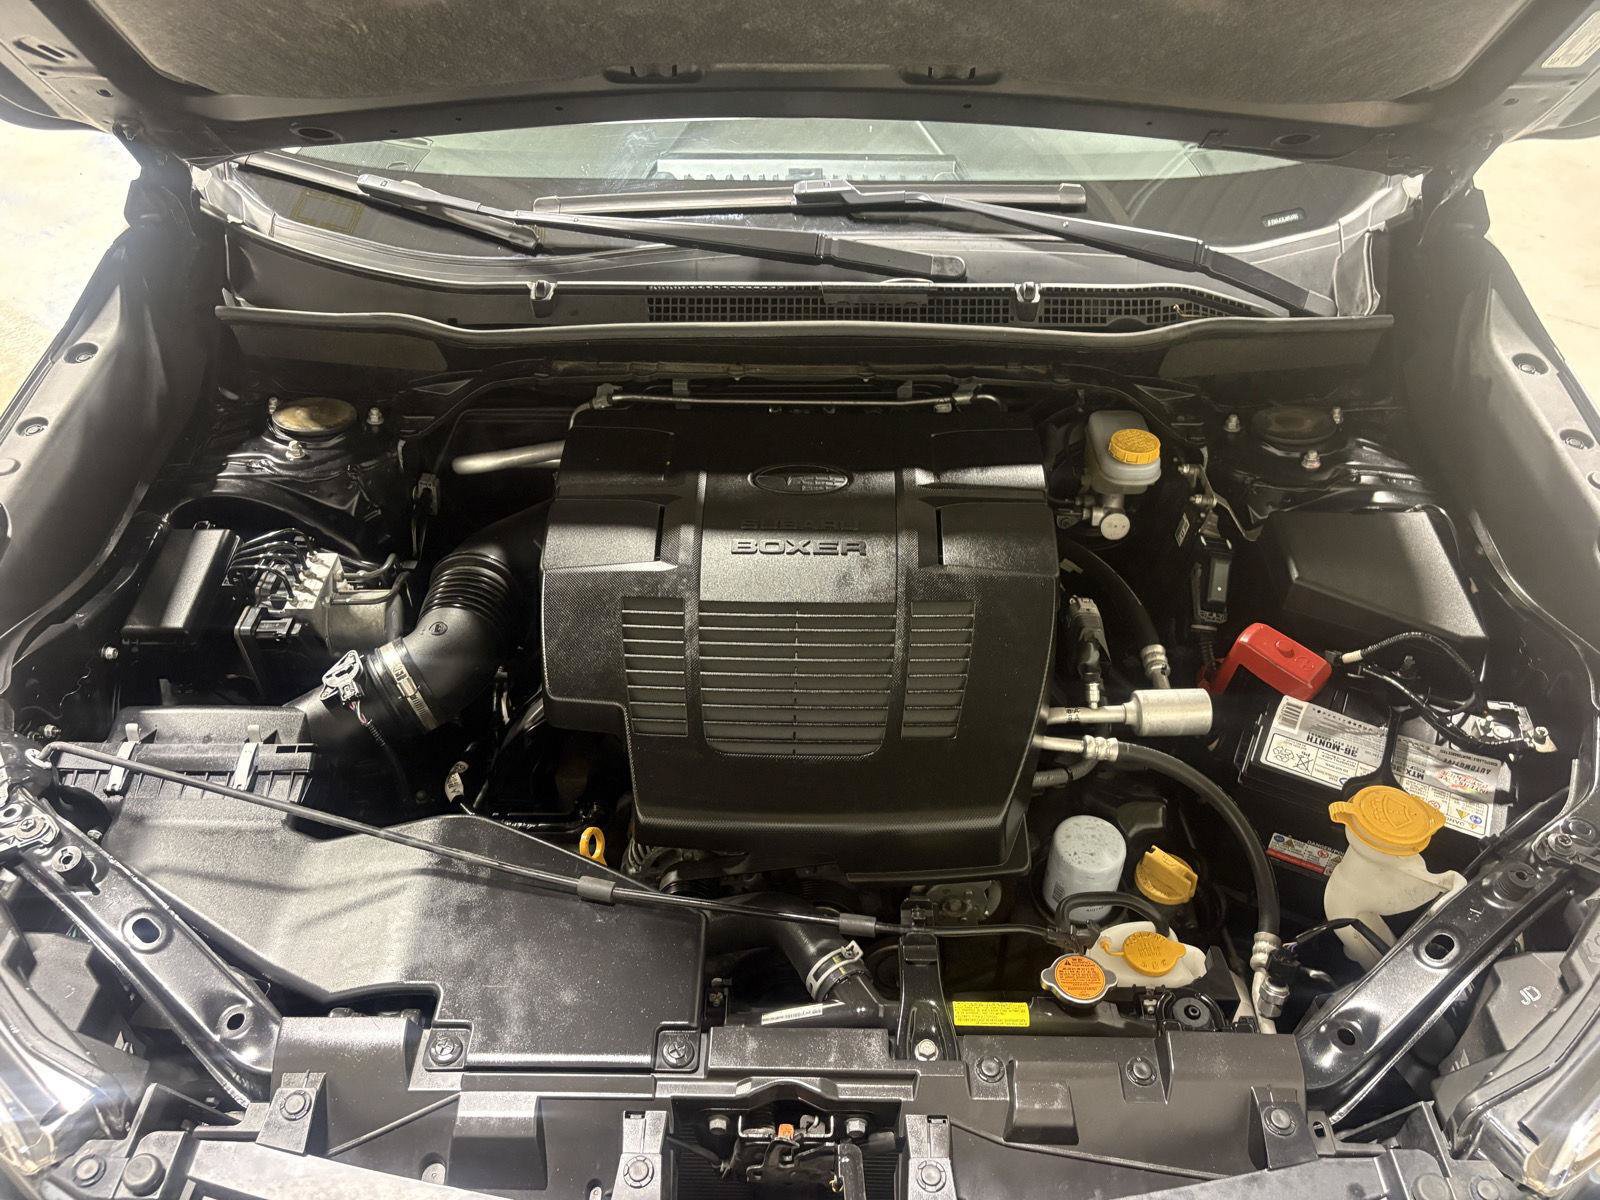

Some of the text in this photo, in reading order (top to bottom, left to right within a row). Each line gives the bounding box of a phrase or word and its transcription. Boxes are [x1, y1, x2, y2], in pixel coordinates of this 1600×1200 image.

[741, 519, 860, 531] SUBARU
[731, 539, 867, 556] BOXER
[1306, 735, 1358, 757] 36-MONTH
[1443, 758, 1491, 775] AUTOMOTIVE
